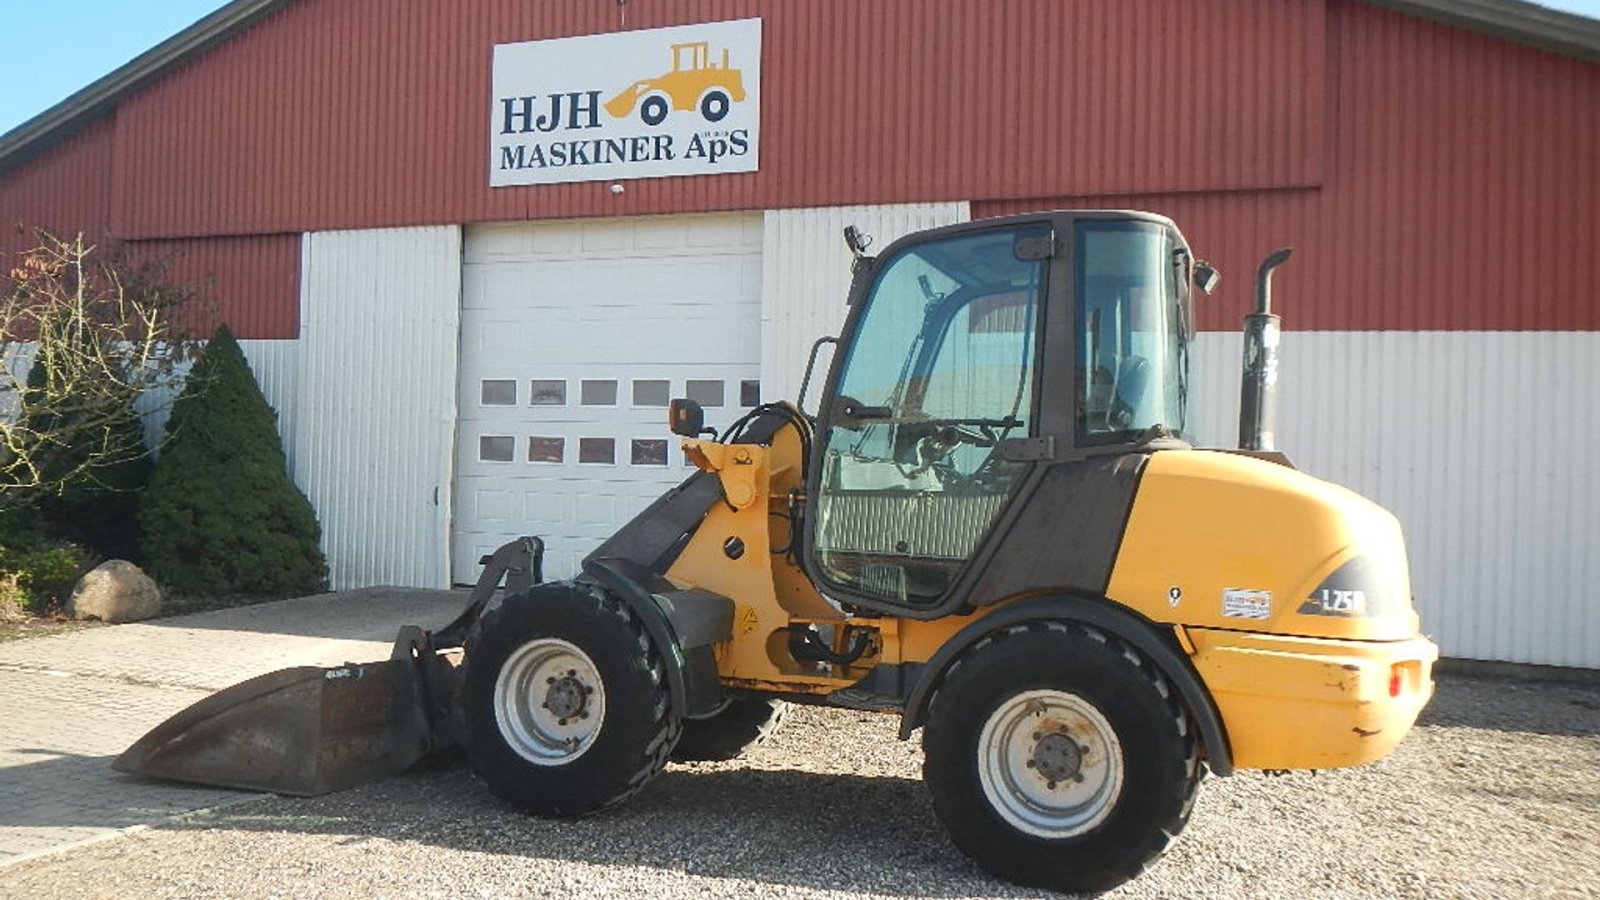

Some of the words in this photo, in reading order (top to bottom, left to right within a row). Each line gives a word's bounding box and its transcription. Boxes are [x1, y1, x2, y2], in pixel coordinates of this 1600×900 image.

[500, 91, 602, 134] HJH
[500, 135, 675, 169] MASKINER
[684, 130, 748, 163] ApS
